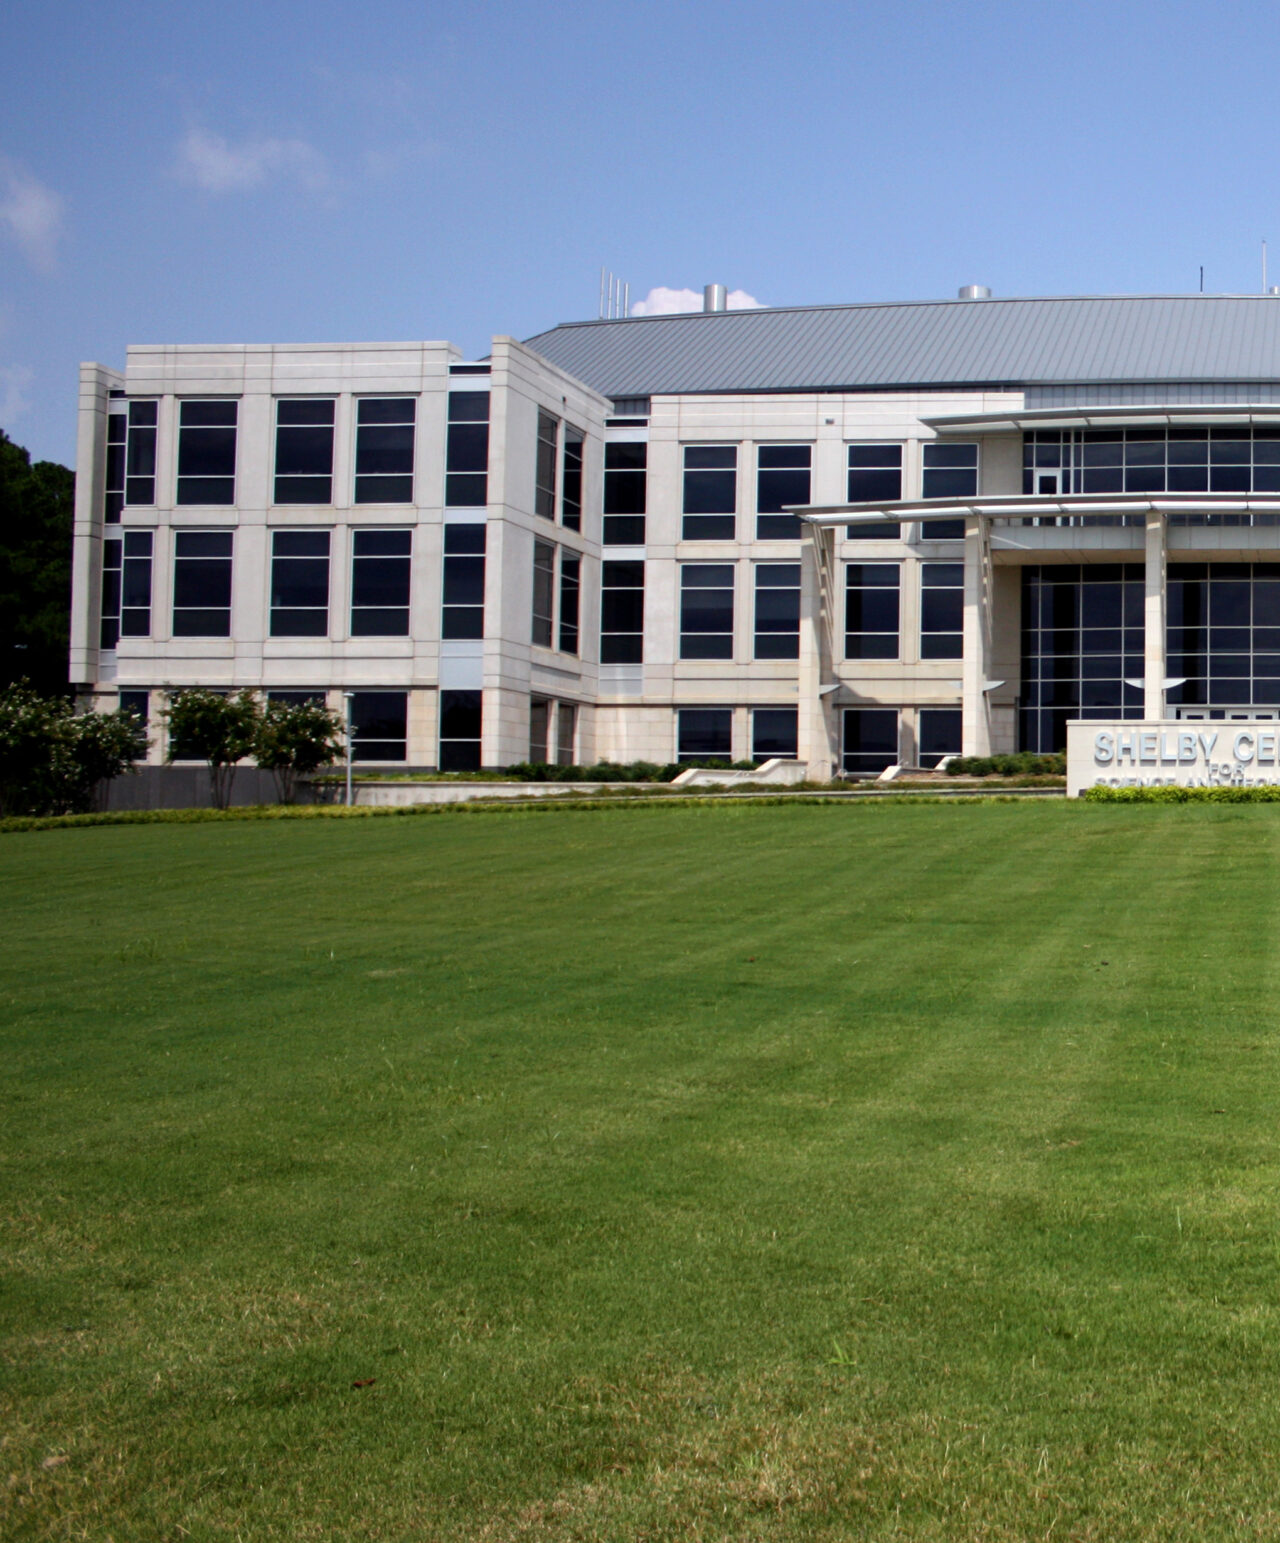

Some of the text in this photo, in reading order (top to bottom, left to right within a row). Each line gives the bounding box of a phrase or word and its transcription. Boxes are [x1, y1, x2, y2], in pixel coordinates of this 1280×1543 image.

[1095, 732, 1217, 762] SHELBY
[1208, 763, 1245, 776] FOR
[1095, 778, 1177, 788] SCIENCE
[1185, 777, 1220, 788] AND
